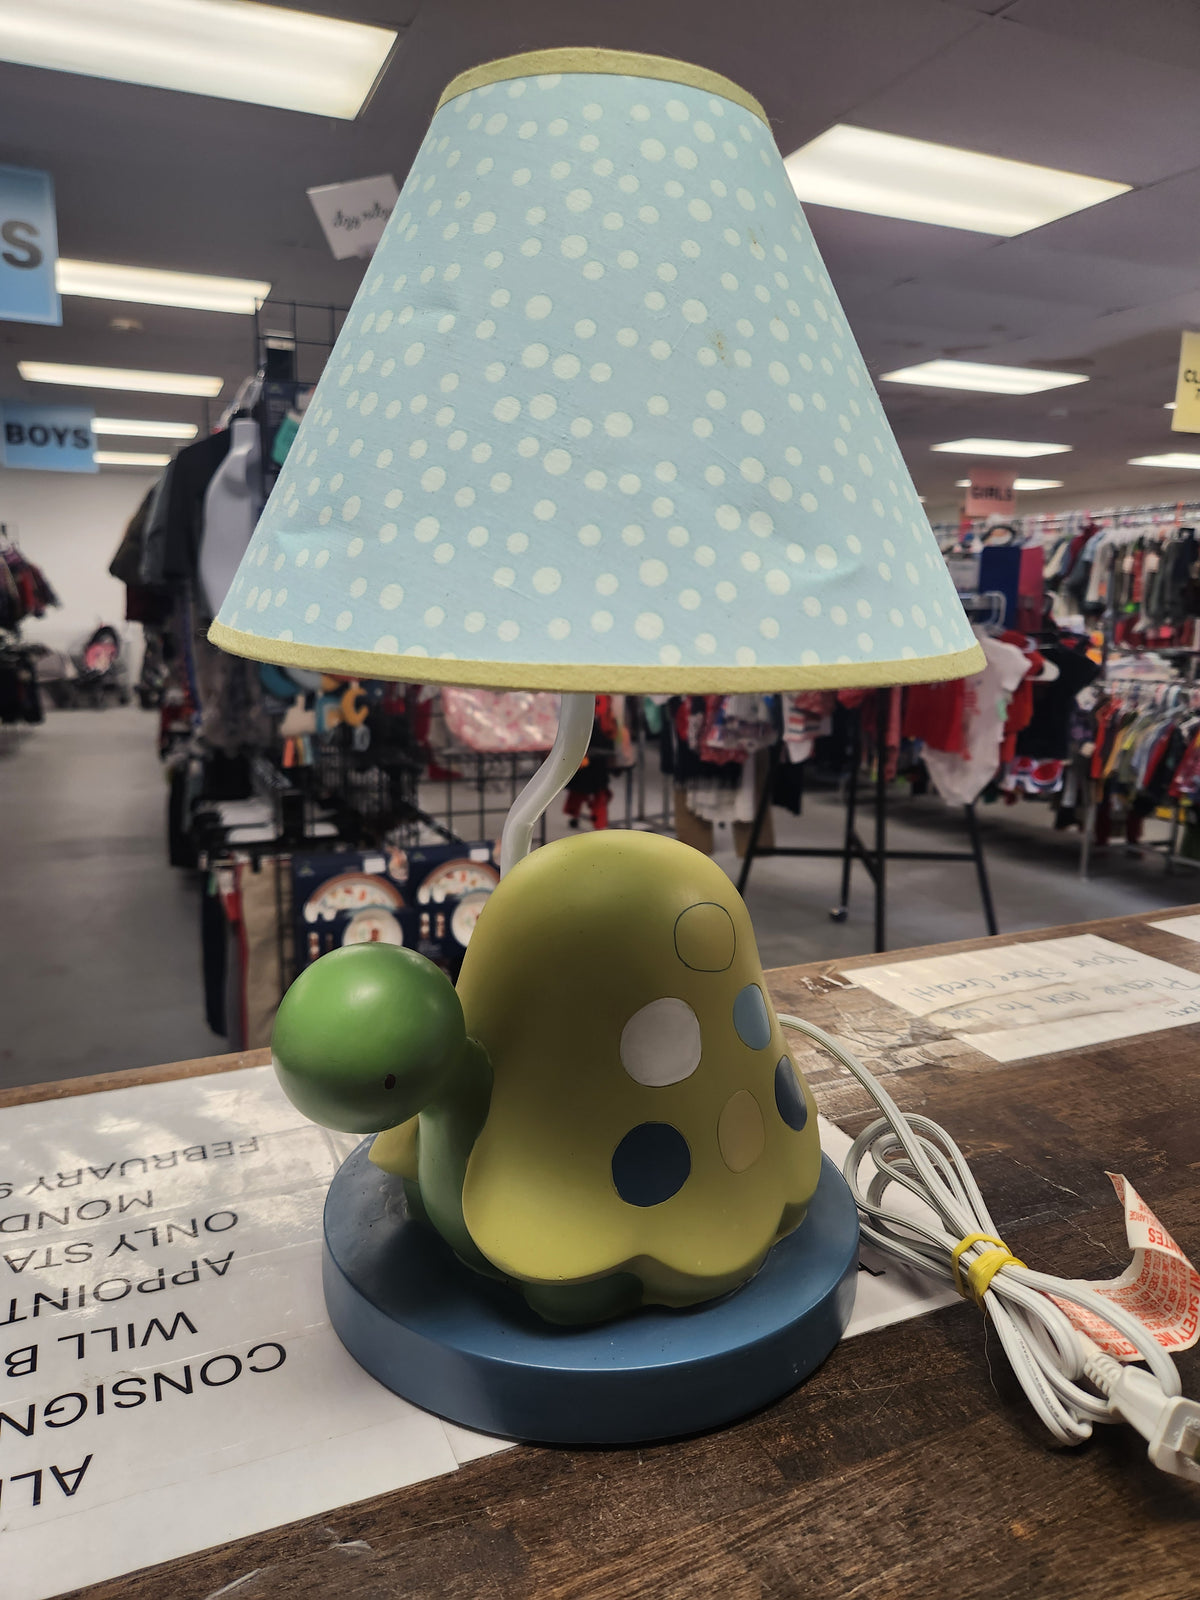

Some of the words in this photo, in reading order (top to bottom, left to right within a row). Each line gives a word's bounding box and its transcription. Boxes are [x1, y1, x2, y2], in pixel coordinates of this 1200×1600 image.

[5, 422, 91, 450] BOYS
[970, 485, 1014, 502] GIRLS
[996, 1000, 1037, 1012] to
[27, 1135, 260, 1196] FEBRUARY
[0, 1189, 154, 1234] MOND
[107, 1210, 239, 1258] ONLY
[3, 1242, 94, 1275] STA
[0, 1250, 235, 1326] APPOINT
[57, 1311, 198, 1360] WILL
[1174, 1292, 1200, 1343] SAFETY
[0, 1453, 94, 1507] AL
